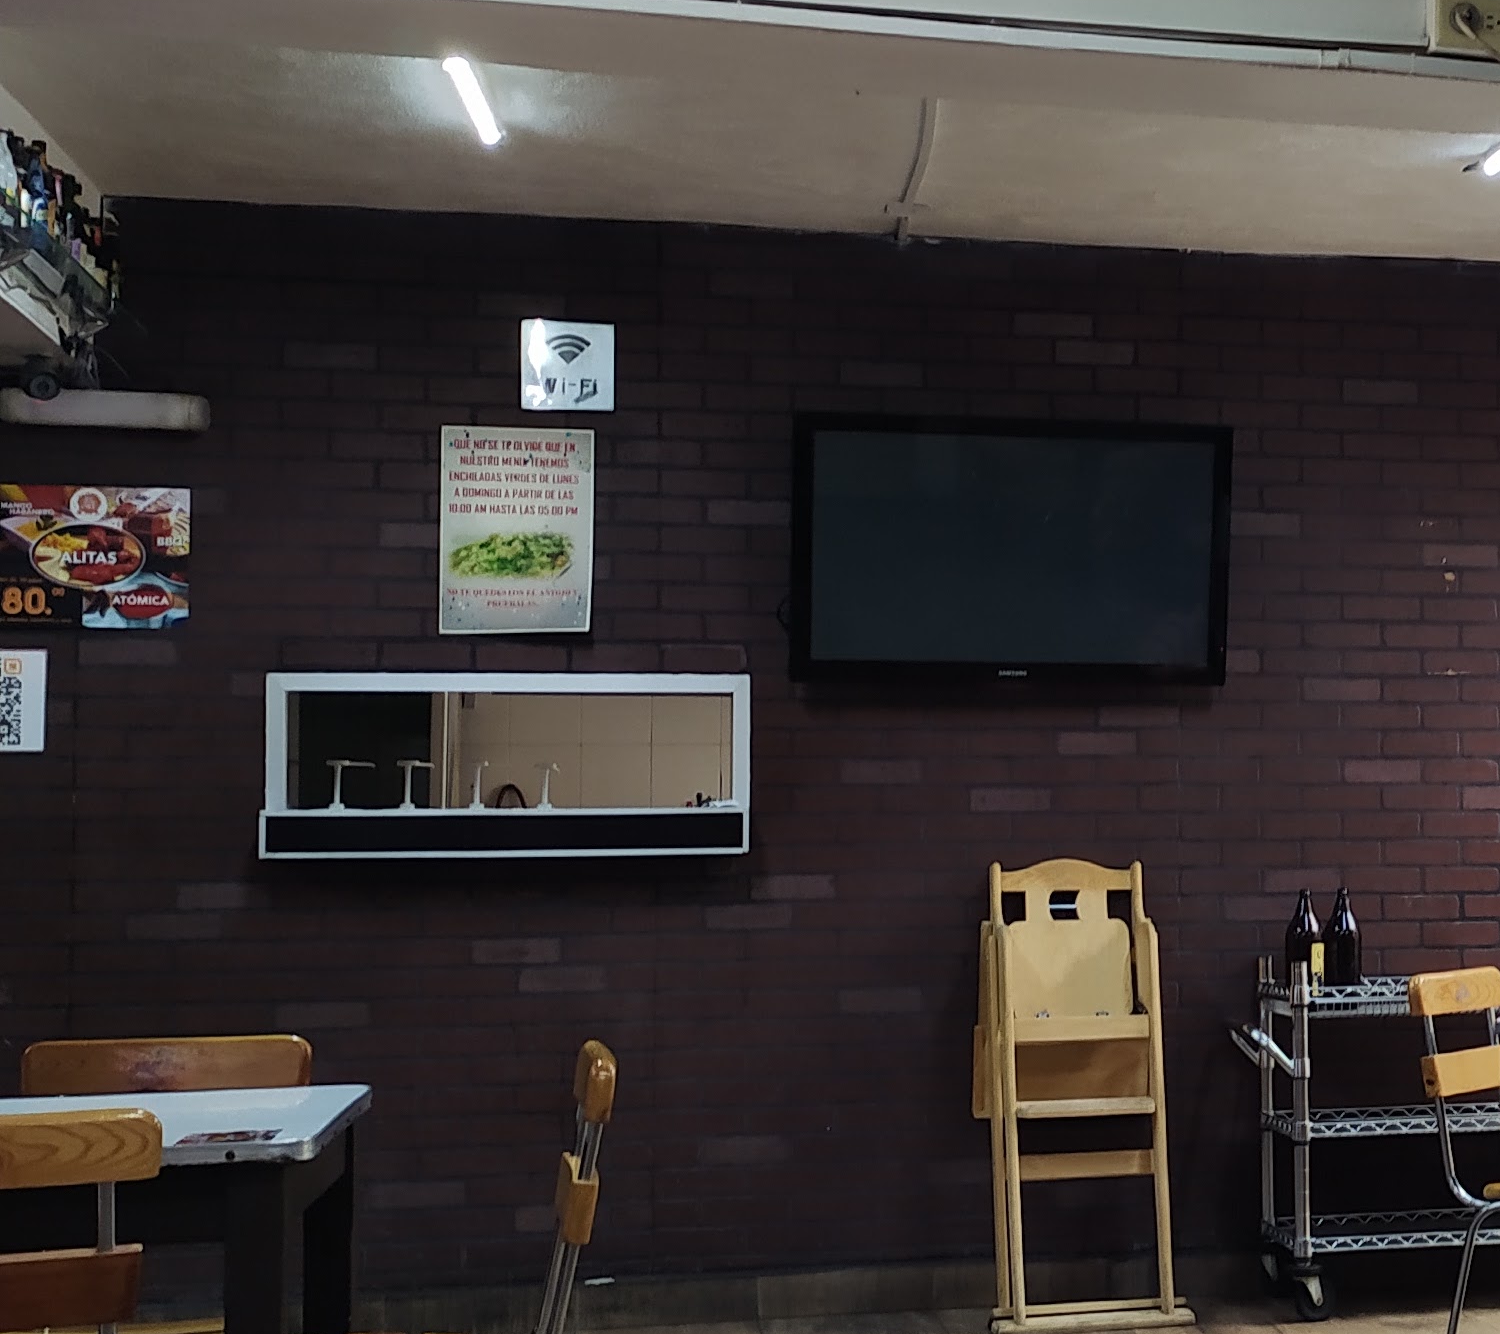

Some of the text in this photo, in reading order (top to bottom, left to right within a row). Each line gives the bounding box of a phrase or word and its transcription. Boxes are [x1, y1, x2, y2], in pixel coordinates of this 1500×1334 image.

[449, 471, 579, 484] ENCHILADAS VERDES DE LUNES
[454, 487, 574, 500] A DOMINGO A PARTIR DE LAS
[474, 504, 487, 514] AM
[489, 504, 517, 515] HASTA
[519, 505, 535, 515] LAS
[565, 506, 578, 516] PM
[156, 536, 185, 548] BBQ
[61, 551, 118, 565] ALITAS
[112, 594, 170, 606] ATÓMICA
